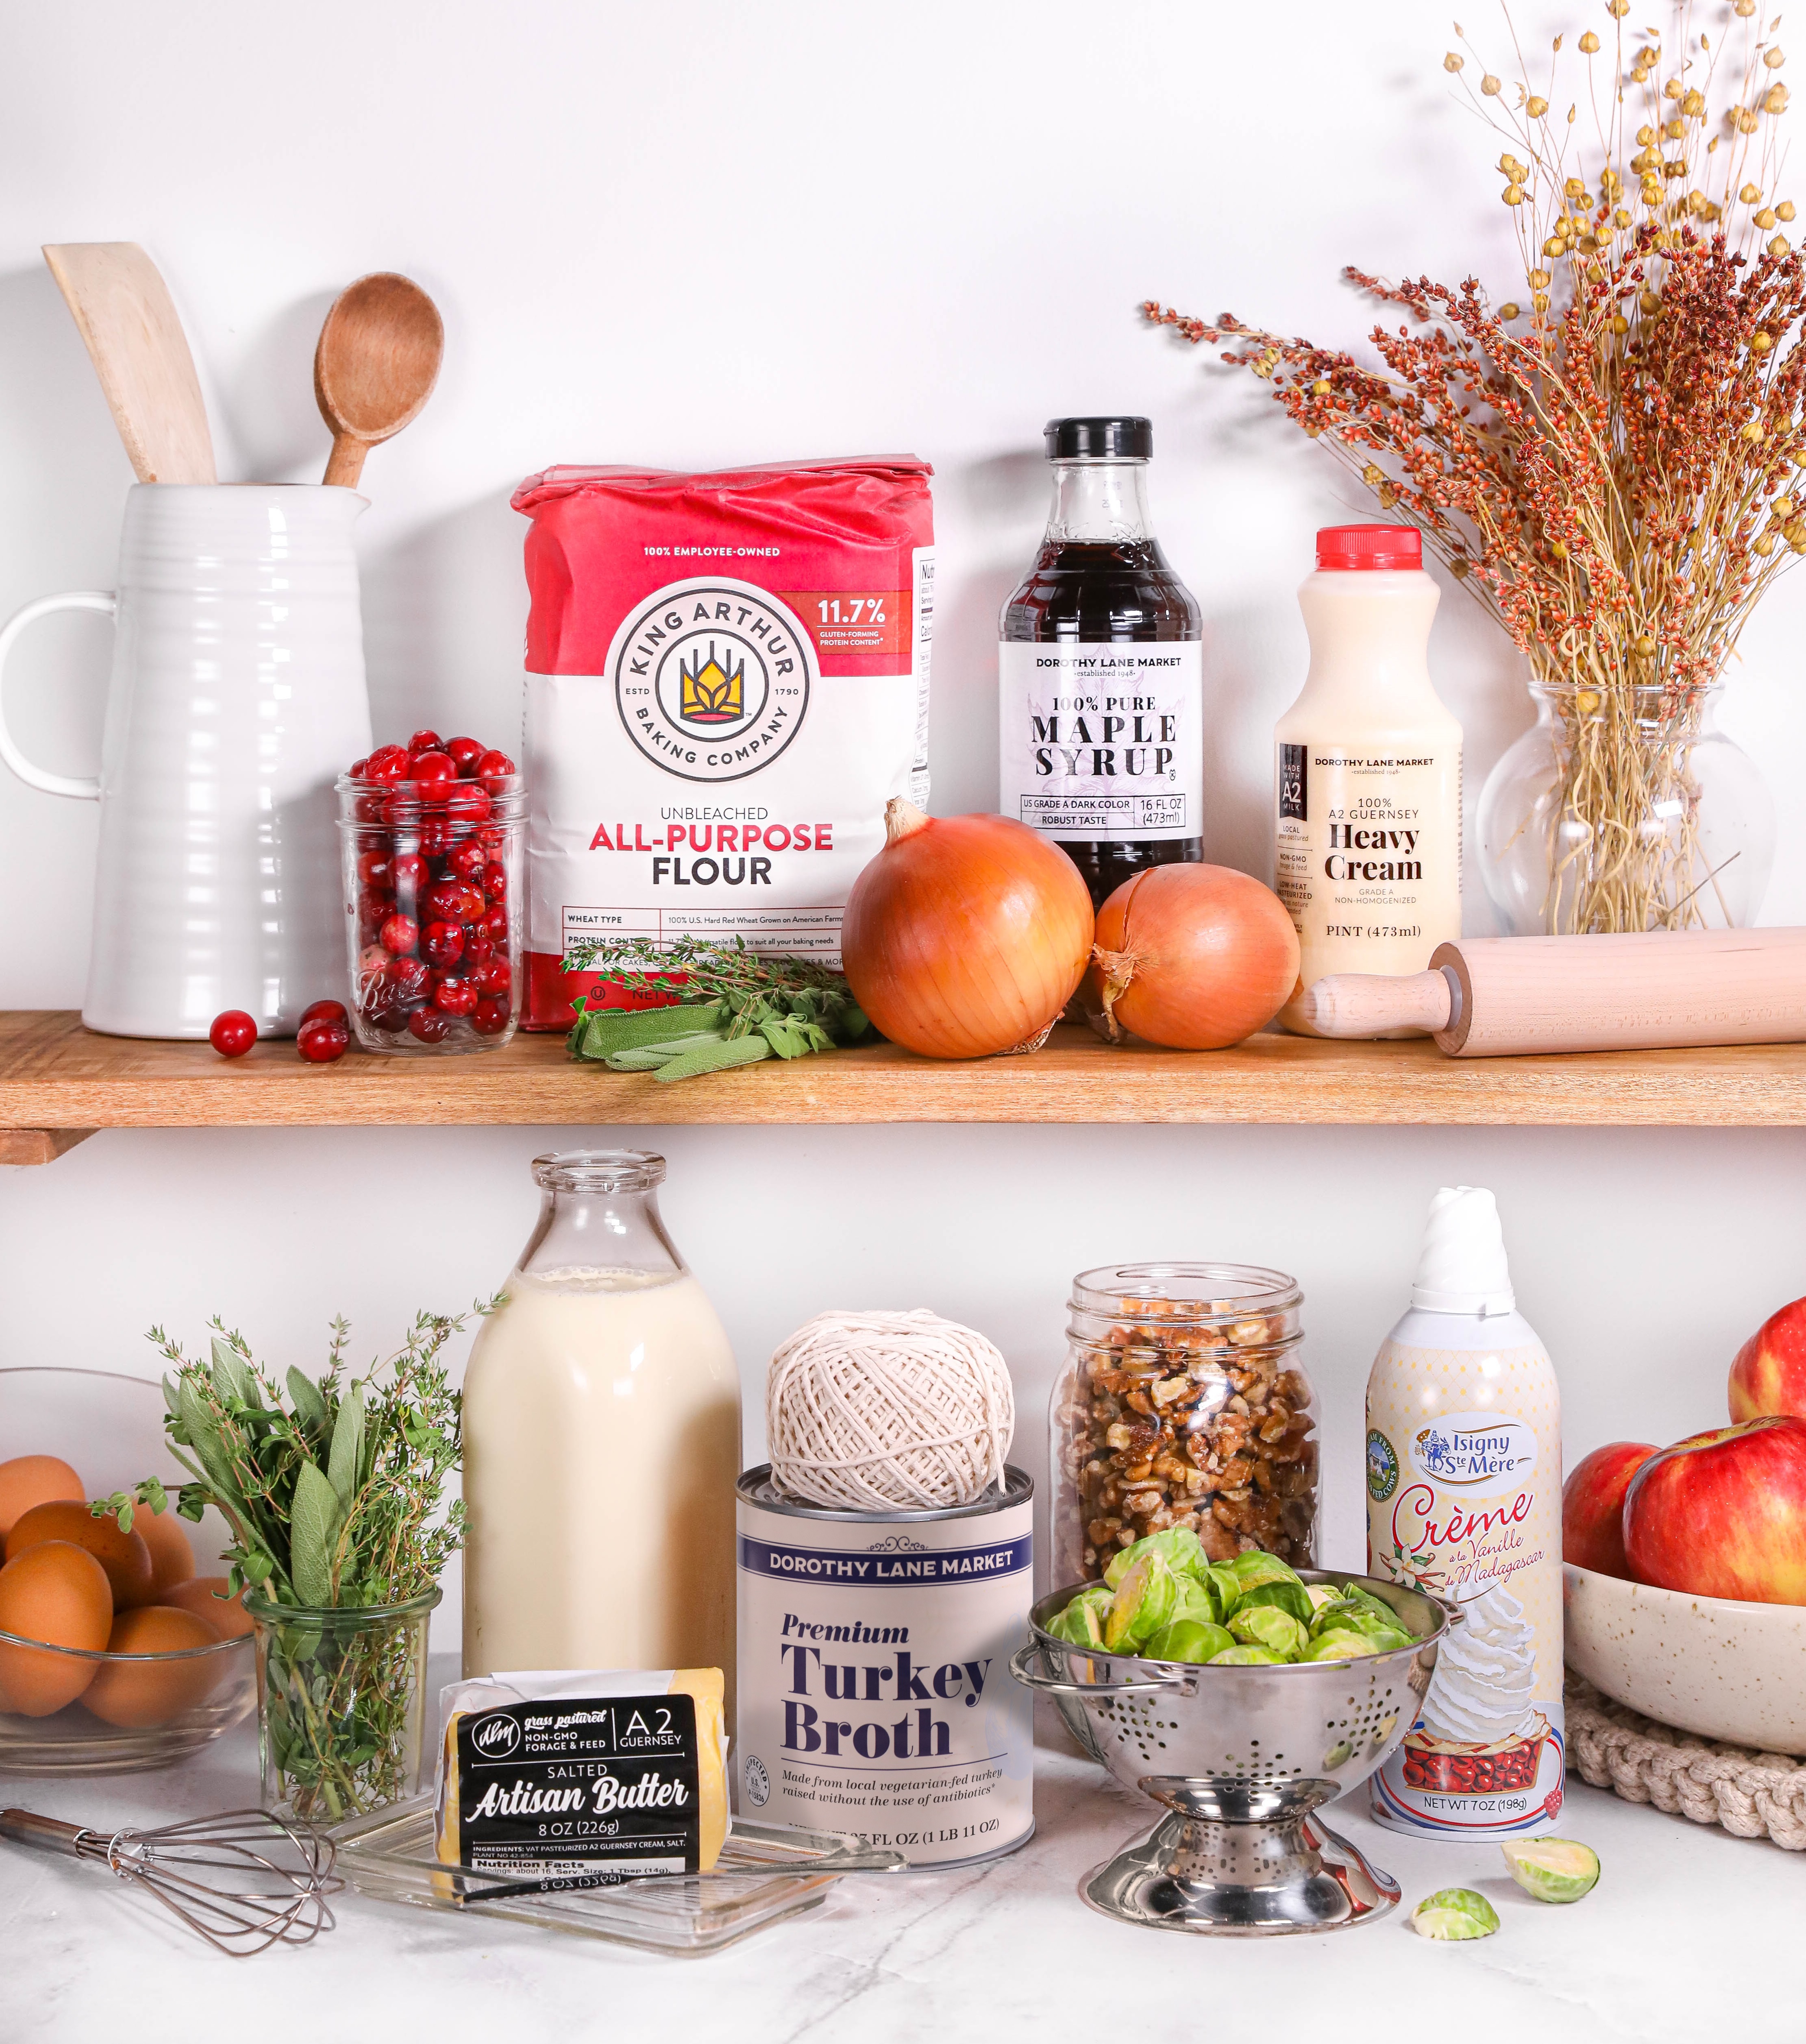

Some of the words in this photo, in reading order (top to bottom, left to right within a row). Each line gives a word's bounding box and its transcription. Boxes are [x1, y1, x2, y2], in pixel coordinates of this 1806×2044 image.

[644, 547, 670, 556] 100%
[674, 547, 780, 556] EMPLOYEE-OWNED
[818, 598, 886, 623] 11.7%
[630, 612, 683, 676] KING
[693, 602, 794, 677] ARTHUR
[1037, 658, 1097, 667] DOROTHY
[1101, 658, 1134, 667] LANE
[1138, 658, 1181, 667] MARKET
[1053, 696, 1098, 711] 100%
[1106, 697, 1155, 710] PURE
[636, 708, 696, 763] BAKING
[707, 706, 788, 766] COMPANY
[1031, 715, 1176, 743] MAPLE
[1036, 748, 1173, 776] SYRUP
[1282, 781, 1301, 803] A2
[1358, 798, 1391, 807] 100%
[661, 808, 768, 819] UNBLEACHED
[1024, 799, 1032, 807] US
[1034, 799, 1060, 808] GRADE
[1062, 800, 1069, 808] A
[1071, 800, 1096, 808] DARK
[1098, 800, 1129, 808] COLOR
[1140, 800, 1152, 810] 16
[1156, 800, 1167, 809] FL
[1170, 799, 1182, 808] OZ
[1284, 803, 1299, 811] MILK
[1042, 816, 1077, 824] ROBUST
[1079, 816, 1106, 824] TASTE
[1143, 813, 1180, 825] (473ml)
[1329, 810, 1344, 819] A2
[1350, 810, 1419, 819] GUERNSEY
[589, 823, 833, 852] ALL-PURPOSE
[1329, 824, 1420, 854] Heavy
[1280, 853, 1306, 862] NON-GMO
[1325, 855, 1423, 880] Cream
[653, 857, 771, 885] FLOUR
[1279, 881, 1307, 890] LOW-HEAT
[793, 938, 814, 946] baking
[1327, 926, 1362, 937] PINT
[1368, 926, 1421, 938] (473ml)
[1379, 1437, 1395, 1464] FROM
[1454, 1435, 1509, 1456] Isigny
[1468, 1456, 1514, 1474] Mère
[1373, 1489, 1383, 1498] FED
[1383, 1471, 1396, 1495] COWS
[1392, 1484, 1533, 1553] Crème
[1458, 1552, 1467, 1561] la
[1467, 1529, 1524, 1558] Vanille
[770, 1552, 869, 1577] DOROTHY
[876, 1561, 936, 1577] LANE
[942, 1549, 1013, 1575] MARKET
[1445, 1576, 1455, 1586] de
[1455, 1550, 1545, 1584] Madagascar
[780, 1613, 909, 1644] Premium
[781, 1643, 993, 1707] Turkey
[524, 1717, 553, 1731] grass
[554, 1710, 607, 1729] pastured
[626, 1709, 674, 1736] A2
[780, 1700, 953, 1759] Broth
[525, 1732, 578, 1742] NON-GMO
[526, 1742, 566, 1752] FORAGE
[570, 1741, 577, 1749] &
[580, 1740, 605, 1748] FEED
[620, 1735, 681, 1748] GUERNSEY
[547, 1765, 607, 1778] SALTED
[746, 1759, 767, 1782] INSPECTED
[782, 1770, 811, 1784] Made
[812, 1776, 842, 1789] from
[846, 1779, 876, 1790] local
[879, 1774, 968, 1793] vegetarian-fed
[971, 1768, 1002, 1783] turkey
[751, 1776, 759, 1787] U.S.
[465, 1780, 585, 1823] Artisan
[592, 1772, 689, 1814] Butter
[749, 1789, 764, 1802] P-15826
[783, 1787, 816, 1800] raised
[818, 1793, 866, 1805] without
[870, 1796, 889, 1806] the
[893, 1798, 914, 1806] use
[918, 1794, 931, 1806] of
[1425, 1796, 1445, 1809] NET
[1448, 1799, 1468, 1810] WT
[1498, 1797, 1527, 1813] (198g)
[538, 1824, 546, 1836] 8
[551, 1823, 573, 1835] OZ
[577, 1820, 619, 1835] (226g)
[872, 1834, 891, 1845] FL
[896, 1833, 919, 1845] OZ
[923, 1831, 934, 1845] (1
[939, 1828, 958, 1841] LB
[963, 1825, 975, 1838] 11
[979, 1818, 999, 1833] OZ)
